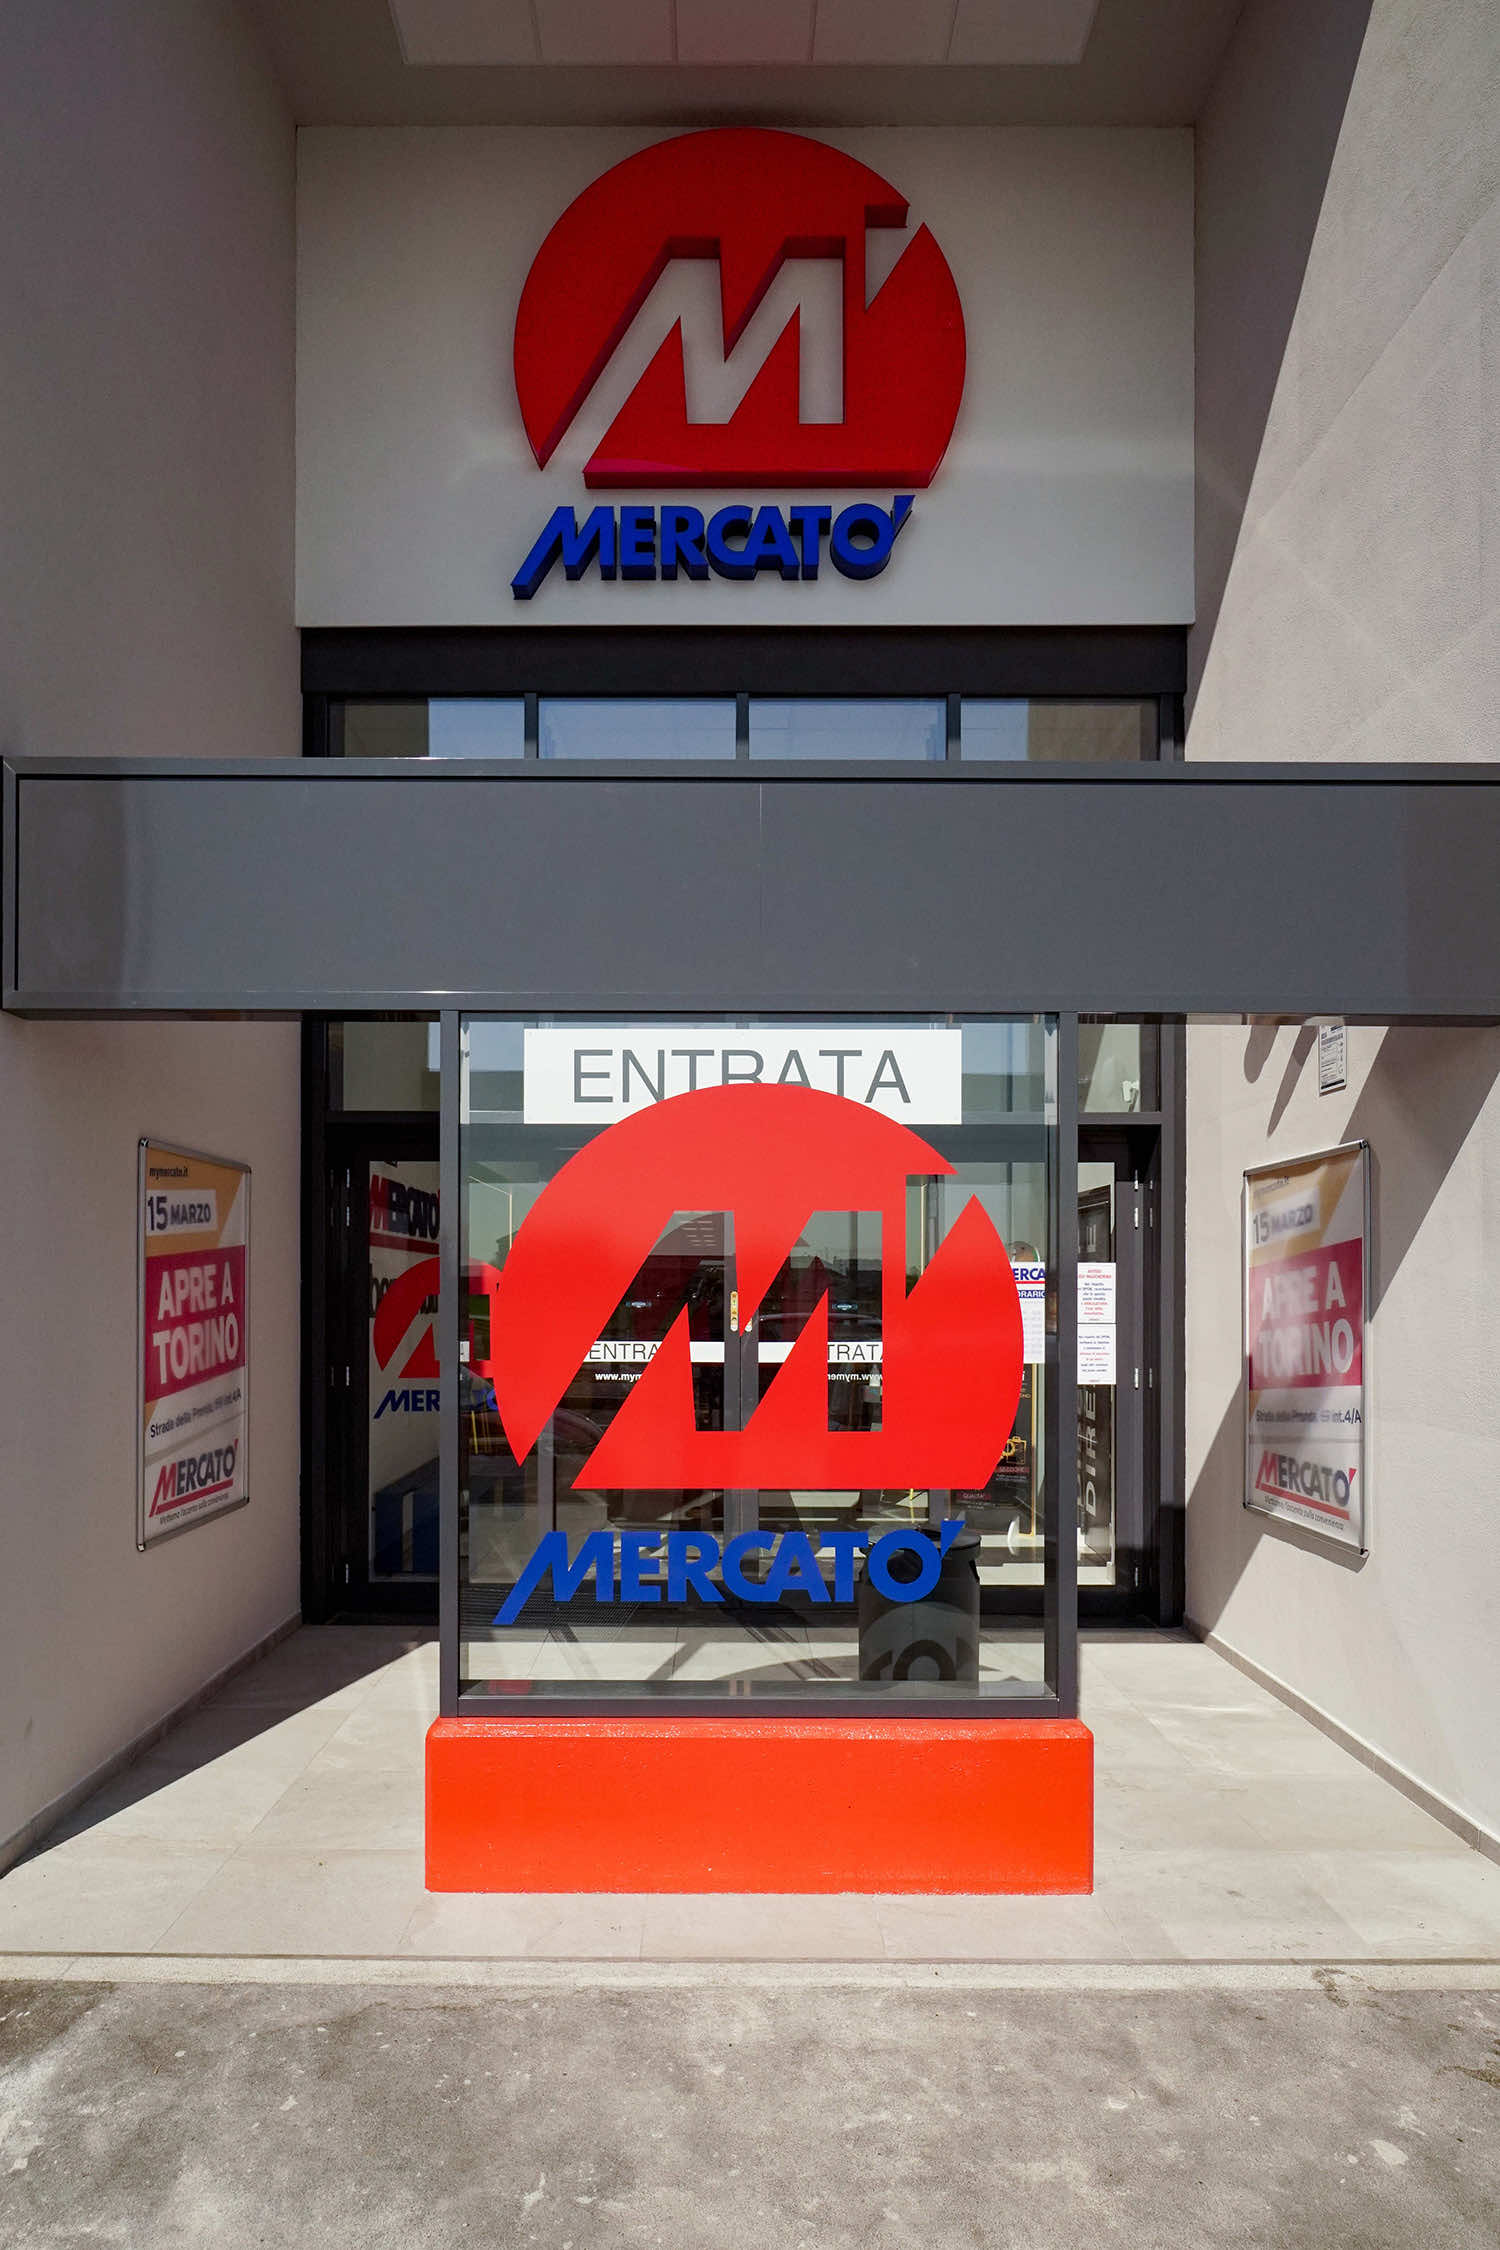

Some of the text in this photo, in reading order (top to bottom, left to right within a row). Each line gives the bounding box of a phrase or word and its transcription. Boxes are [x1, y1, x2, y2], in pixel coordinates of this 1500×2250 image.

[573, 1049, 911, 1103] ENTRATA
[147, 1196, 212, 1231] 15 MARZO
[1253, 1211, 1270, 1244] 15
[158, 1260, 234, 1320] APRE A
[1012, 1267, 1046, 1281] ERCA
[1262, 1261, 1347, 1320] APRE A
[153, 1312, 239, 1385] TORINO
[828, 1344, 883, 1360] TRAT
[1258, 1318, 1354, 1380] TORINO
[374, 1389, 440, 1420] MER
[150, 1419, 174, 1438] Strada
[1085, 1388, 1097, 1517] DIRE
